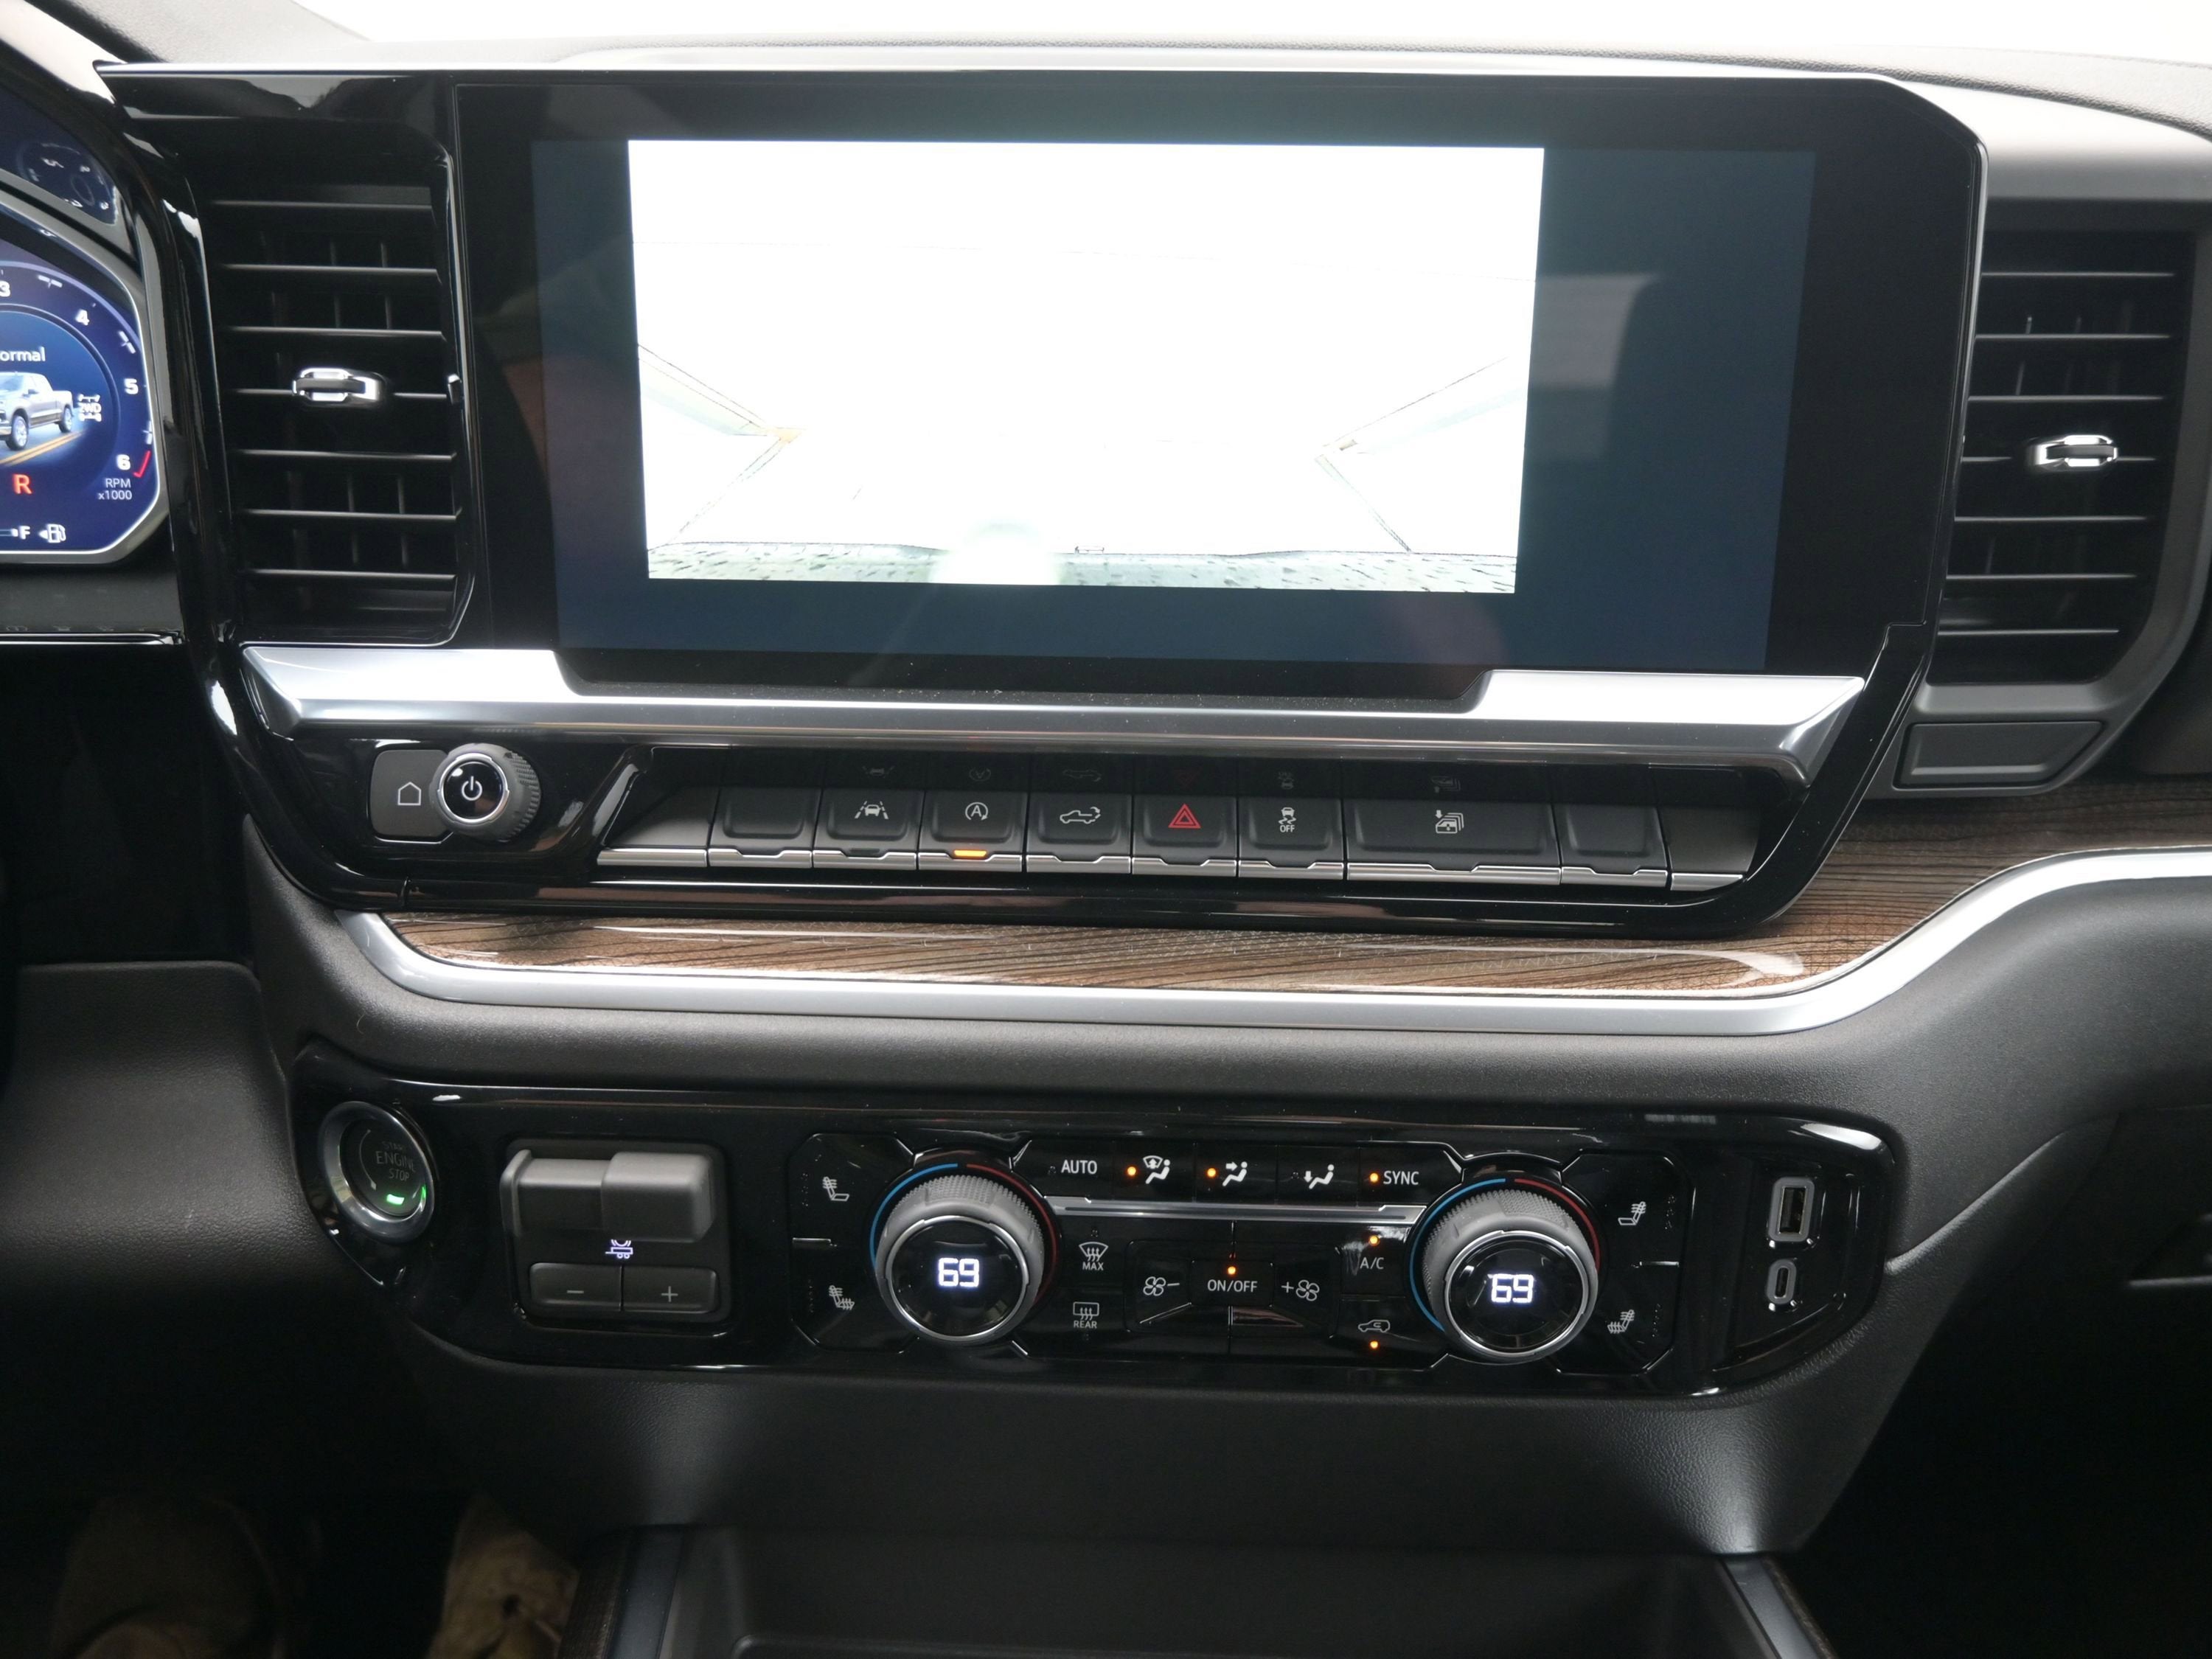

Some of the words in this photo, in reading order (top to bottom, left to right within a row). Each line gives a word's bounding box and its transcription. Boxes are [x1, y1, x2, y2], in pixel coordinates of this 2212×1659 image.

[75, 309, 90, 326] 4
[0, 347, 46, 362] ormal
[124, 378, 139, 394] 5
[116, 454, 131, 470] 6
[13, 473, 32, 494] R
[105, 478, 131, 488] RPM
[98, 490, 132, 501] x1000
[19, 526, 31, 540] F
[1279, 824, 1295, 833] OFF
[389, 1167, 410, 1182] STOP
[1060, 1159, 1098, 1175] AUTO
[1382, 1170, 1419, 1186] SYNC
[1082, 1262, 1105, 1271] MAX
[1359, 1256, 1385, 1270] A/C
[936, 1256, 981, 1288] 69
[1207, 1279, 1258, 1293] ON/OFF
[1490, 1273, 1534, 1304] 69
[1073, 1320, 1098, 1329] REAR
